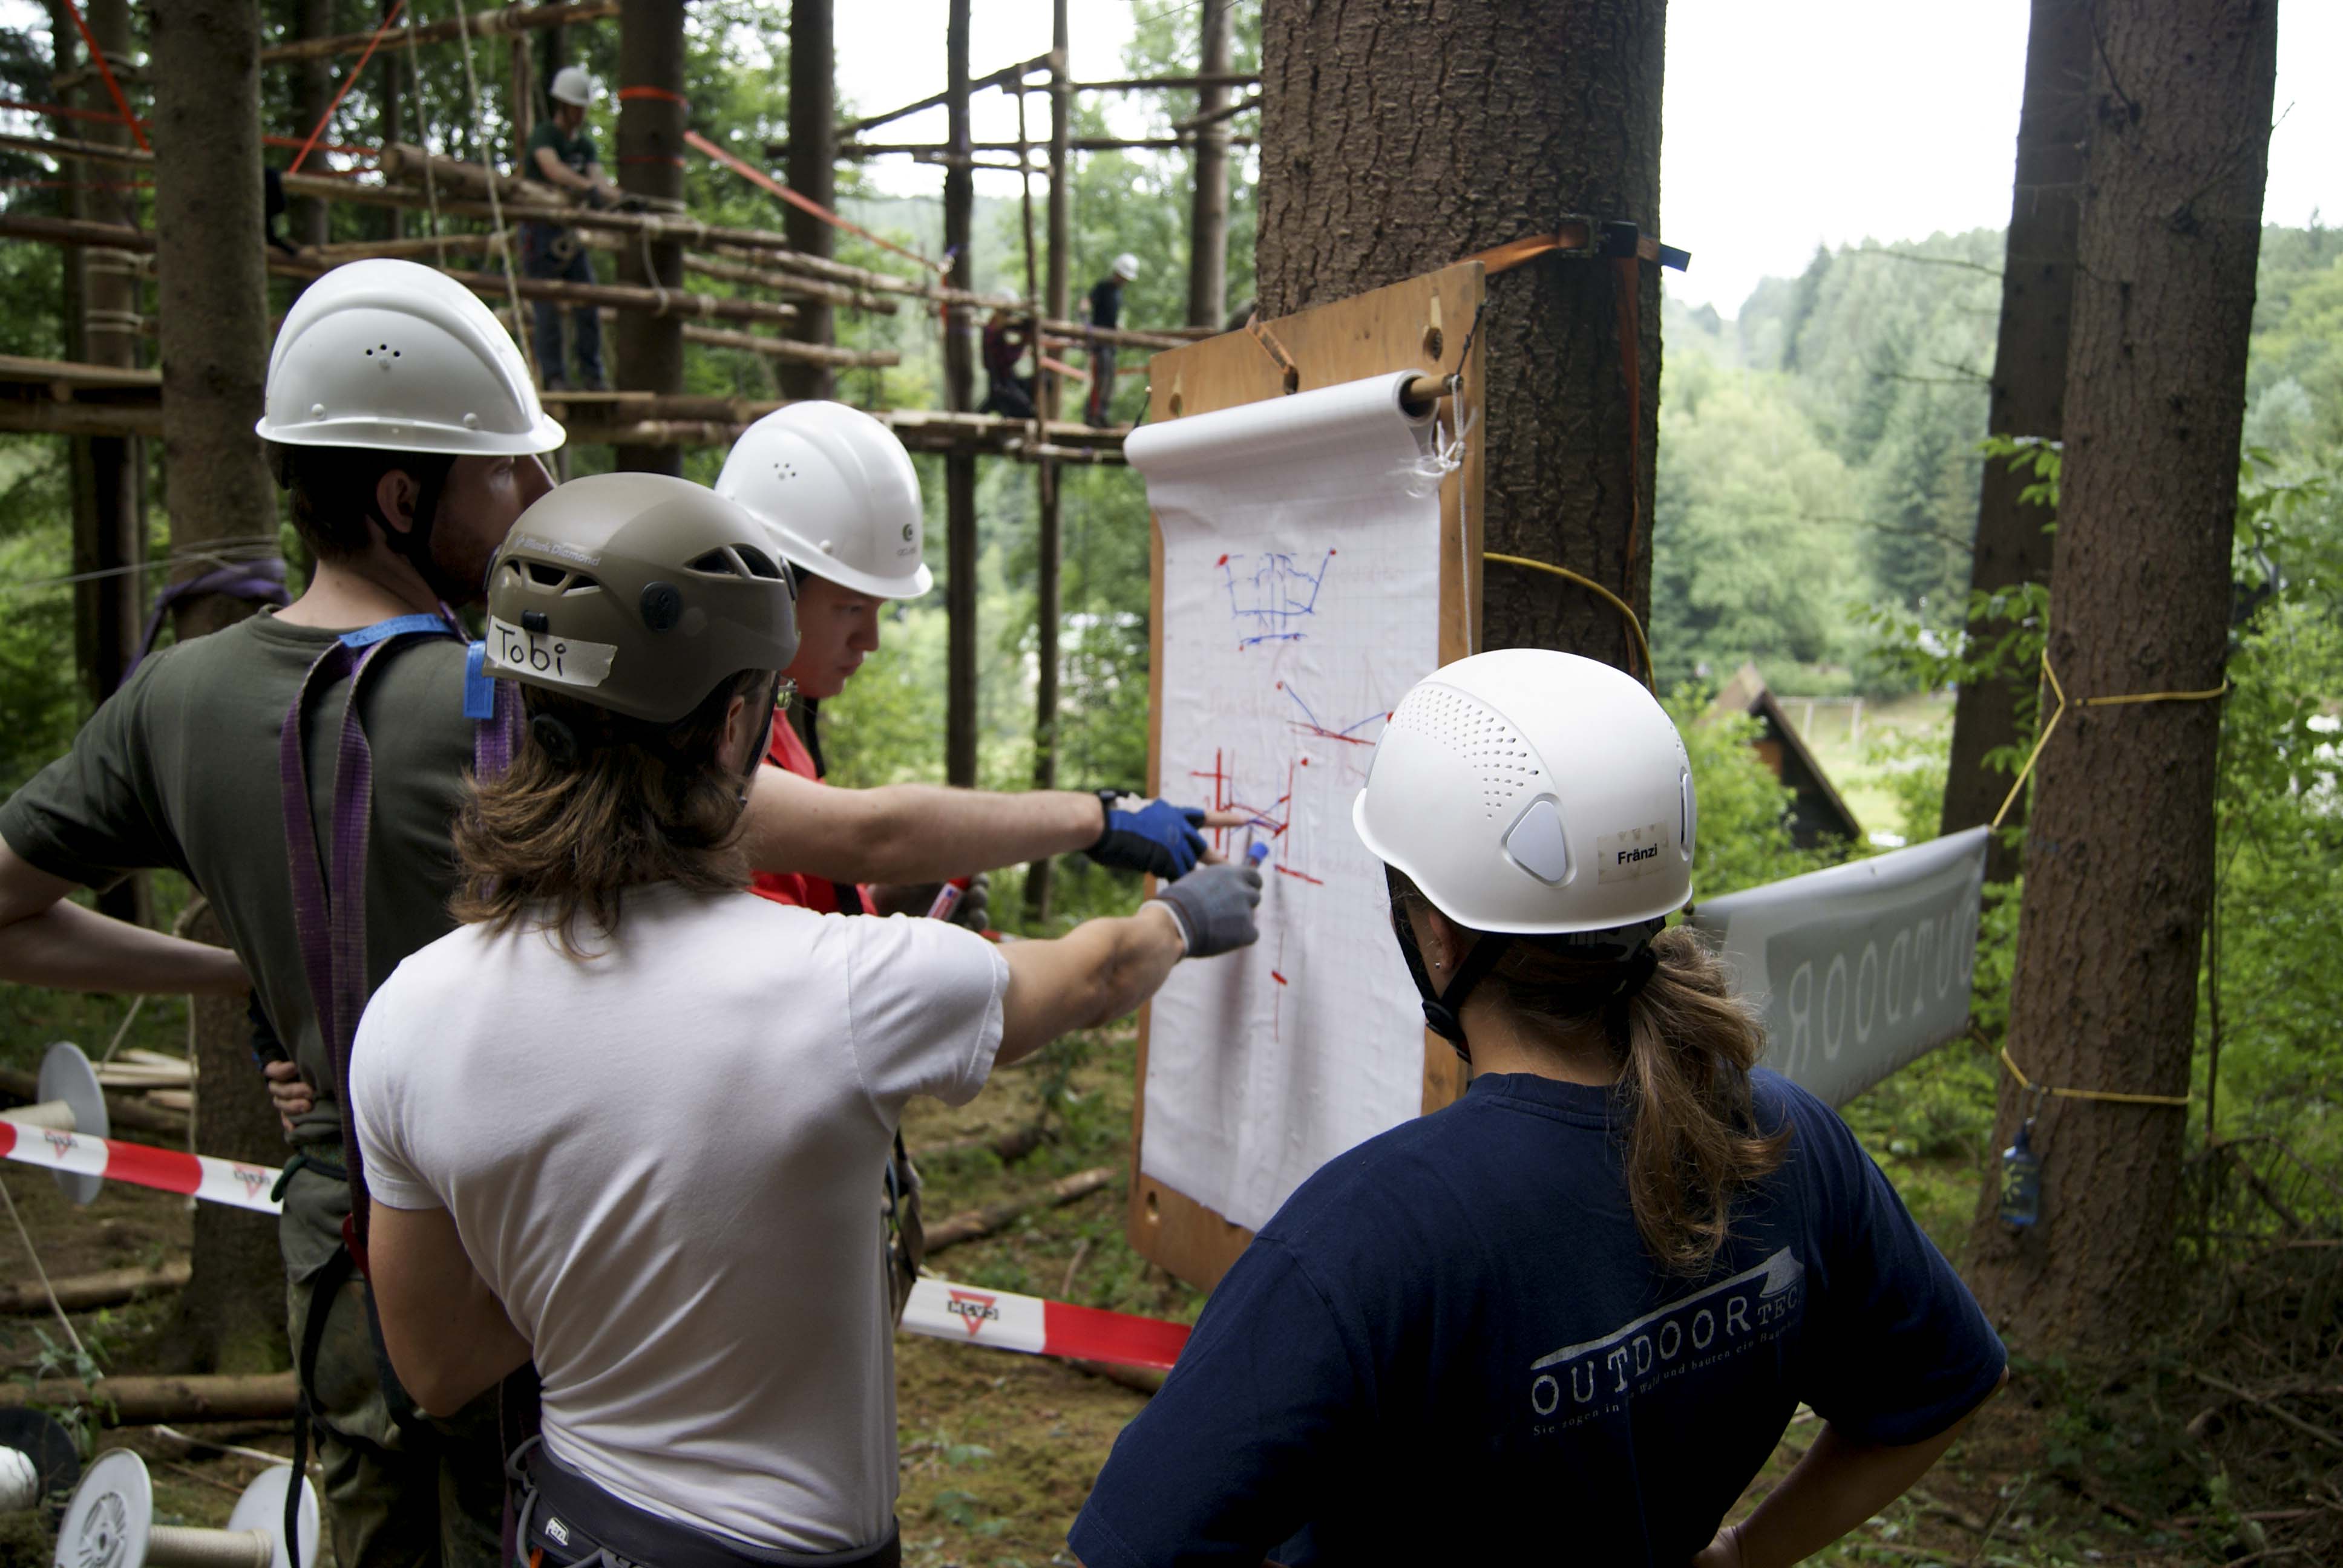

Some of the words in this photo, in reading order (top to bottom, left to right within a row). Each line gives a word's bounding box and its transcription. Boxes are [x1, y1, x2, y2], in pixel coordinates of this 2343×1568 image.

[550, 544, 601, 566] Diamond
[496, 624, 566, 677] Tobi
[1617, 843, 1657, 864] Fränzi
[1531, 1295, 1752, 1416] OUTDOOR
[1533, 1425, 1555, 1436] Sie
[1562, 1409, 1599, 1428] zogen
[1605, 1402, 1619, 1413] in
[1663, 1362, 1685, 1379] und
[1691, 1350, 1730, 1370] bauten
[1736, 1340, 1754, 1354] ein
